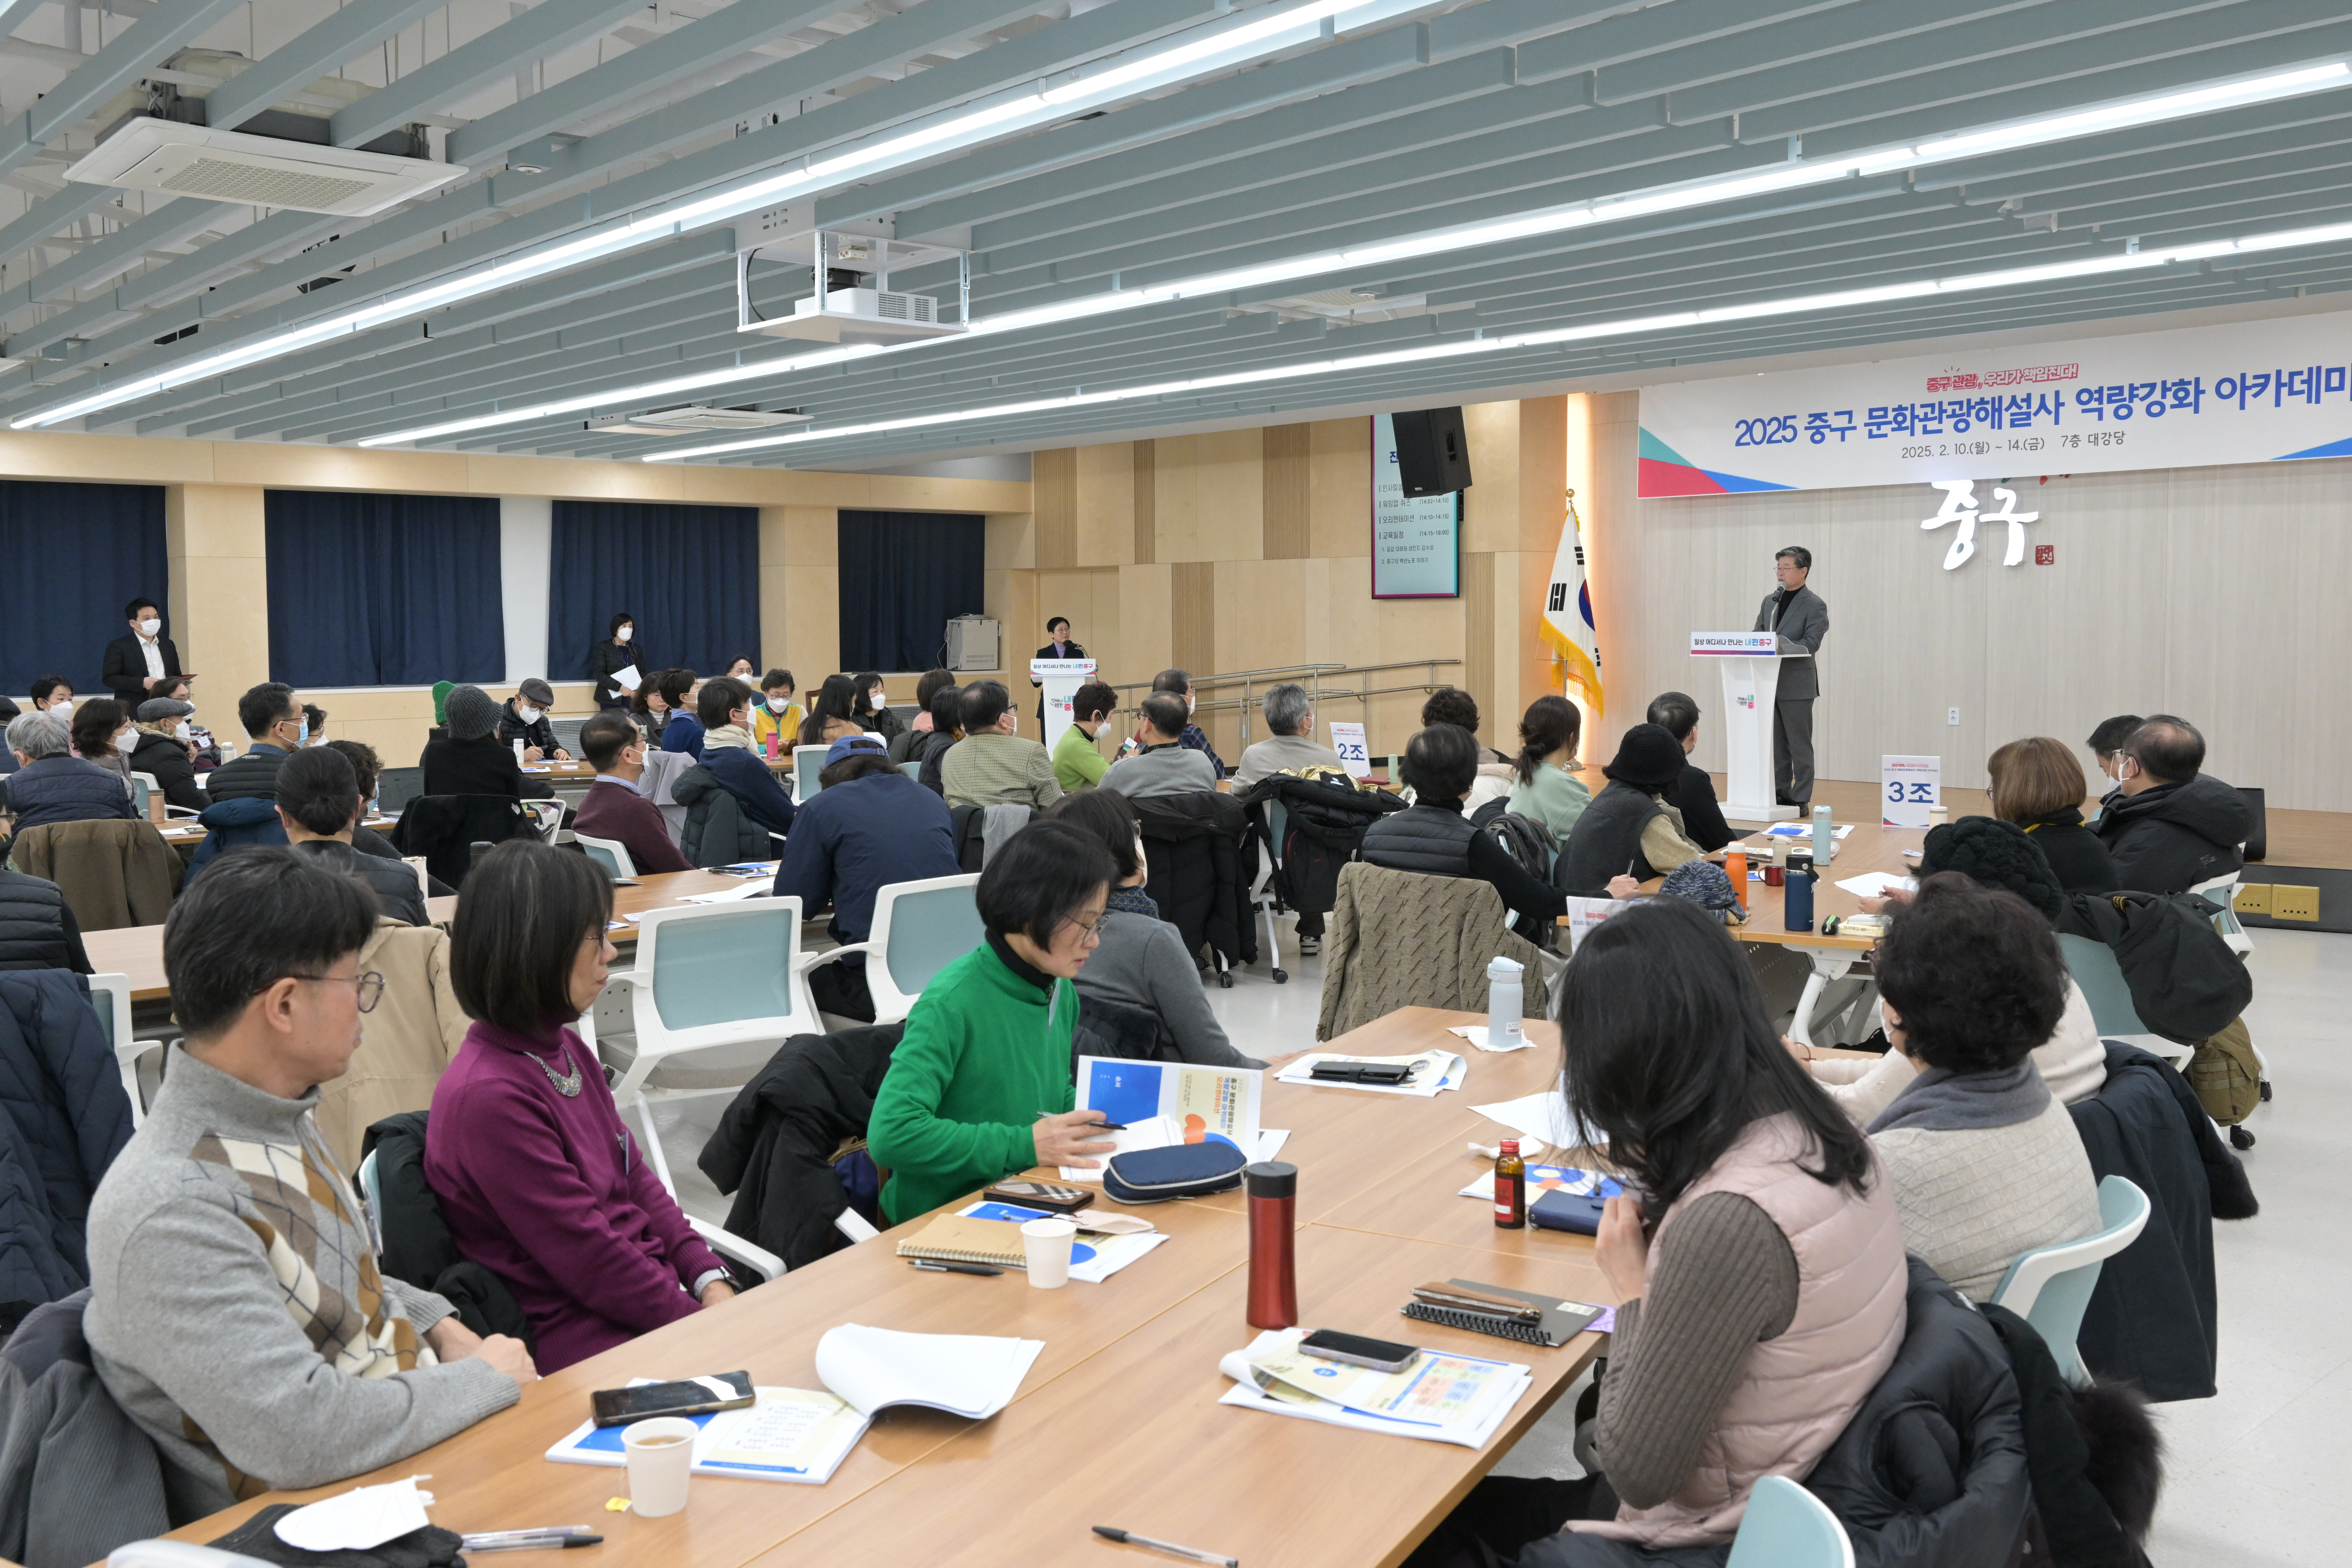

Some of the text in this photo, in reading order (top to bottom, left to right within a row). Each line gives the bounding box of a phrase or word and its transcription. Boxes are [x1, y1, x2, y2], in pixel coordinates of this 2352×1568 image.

[1927, 376, 1952, 392] 중구
[1984, 369, 2022, 387] 우리가
[2022, 363, 2079, 383] 책임진다!
[1734, 363, 2352, 447] 2025 중구 문화관광해설사 역량강화 아카데미
[1901, 445, 1934, 459] 2025.
[1940, 444, 1949, 456] 2.
[1955, 440, 1990, 455] 10.(월)
[2008, 438, 2045, 453] 14.(금)
[2060, 433, 2081, 448] 7층
[2088, 431, 2126, 447] 대강당
[1383, 499, 1398, 508] 워밍업
[1400, 499, 1411, 507] 퀴즈
[1383, 515, 1414, 524] 오리엔테이션
[1920, 479, 2039, 570] 중구
[1383, 531, 1404, 539] 교육일정
[1338, 743, 1365, 761] 2조
[1888, 781, 1934, 803] 3조
